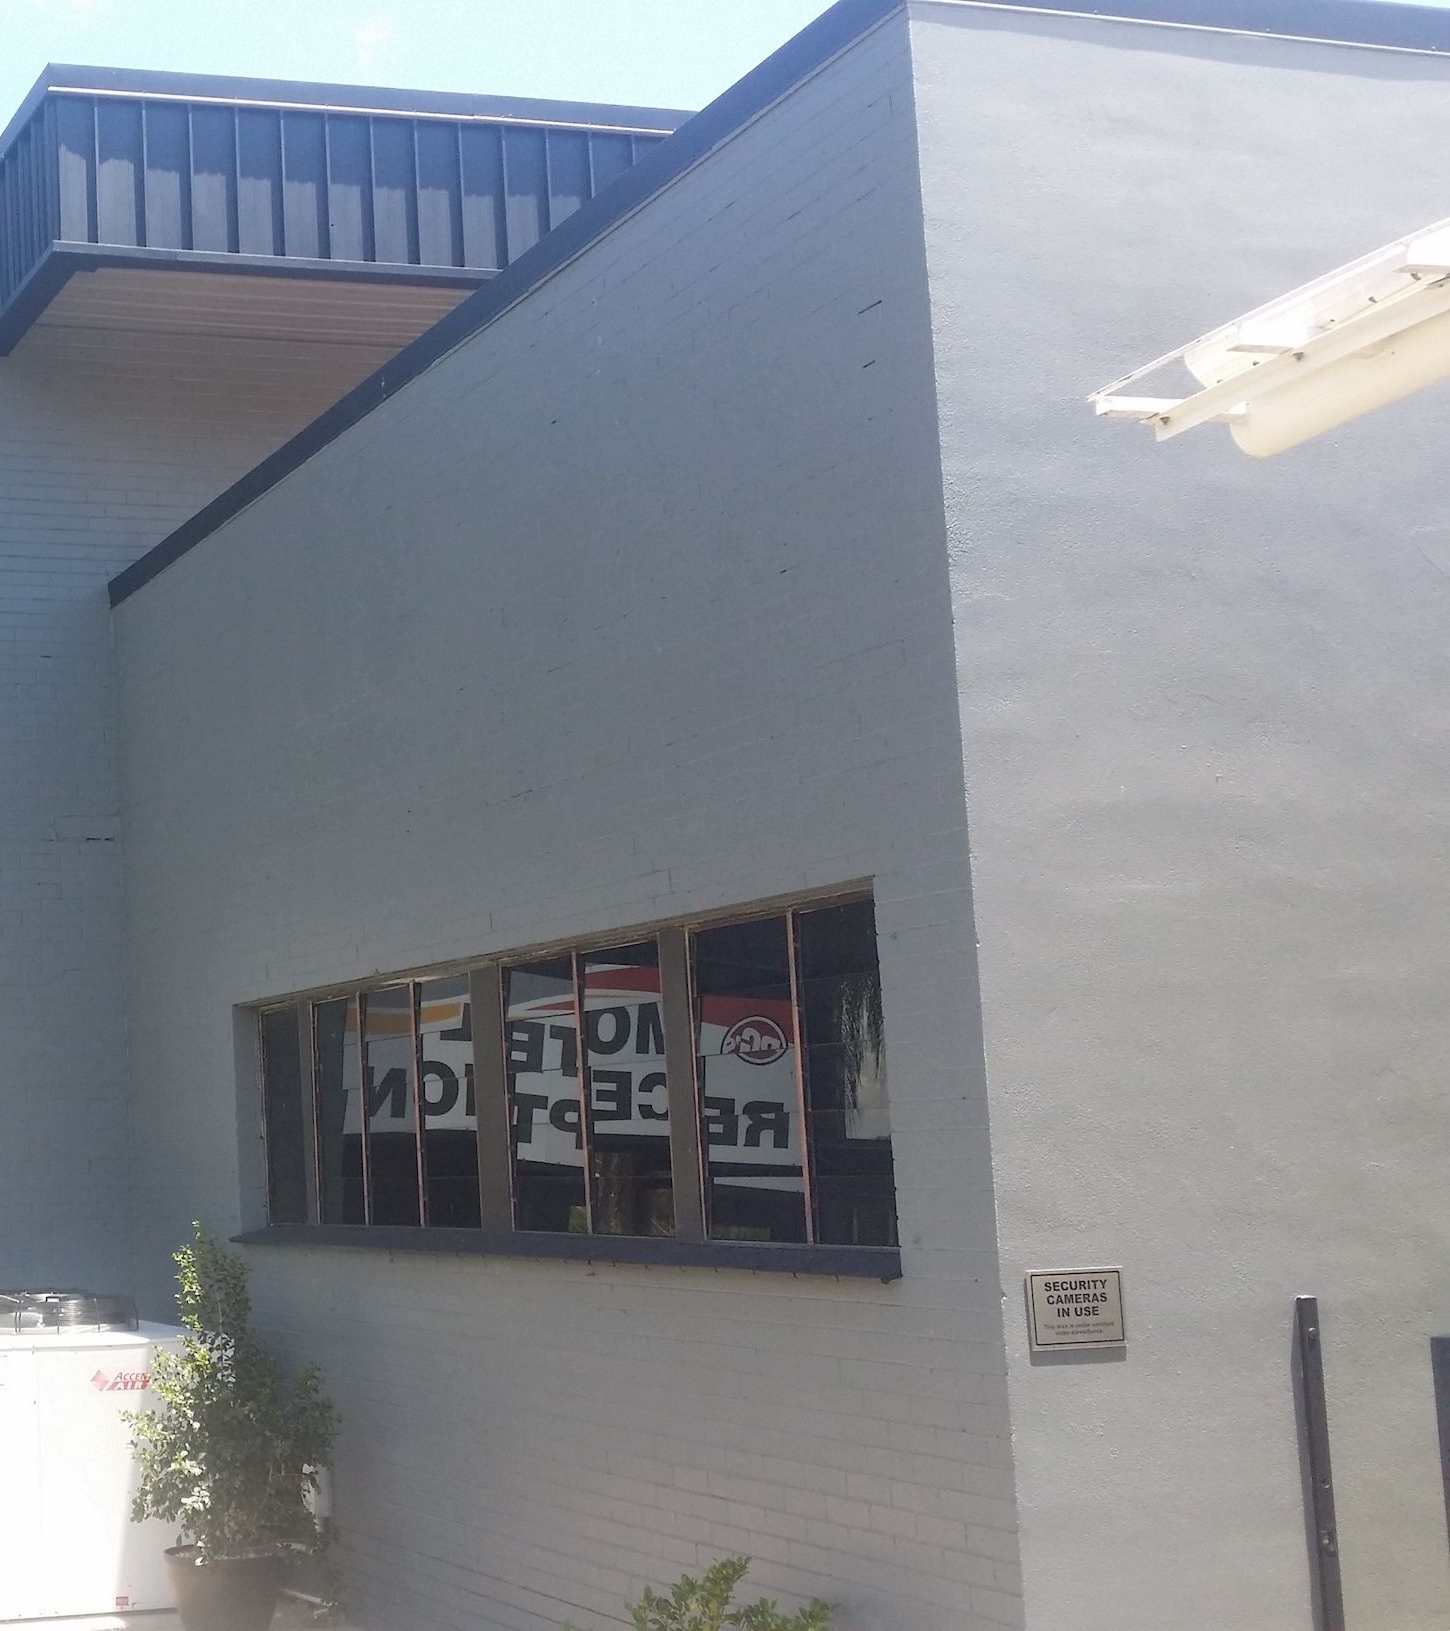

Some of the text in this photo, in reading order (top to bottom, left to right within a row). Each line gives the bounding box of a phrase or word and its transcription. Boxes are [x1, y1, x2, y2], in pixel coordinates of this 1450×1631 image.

[1044, 1279, 1107, 1292] SECURITY
[1046, 1292, 1108, 1305] CAMERAS
[1057, 1306, 1100, 1318] IN USE
[115, 1382, 143, 1390] AIR
